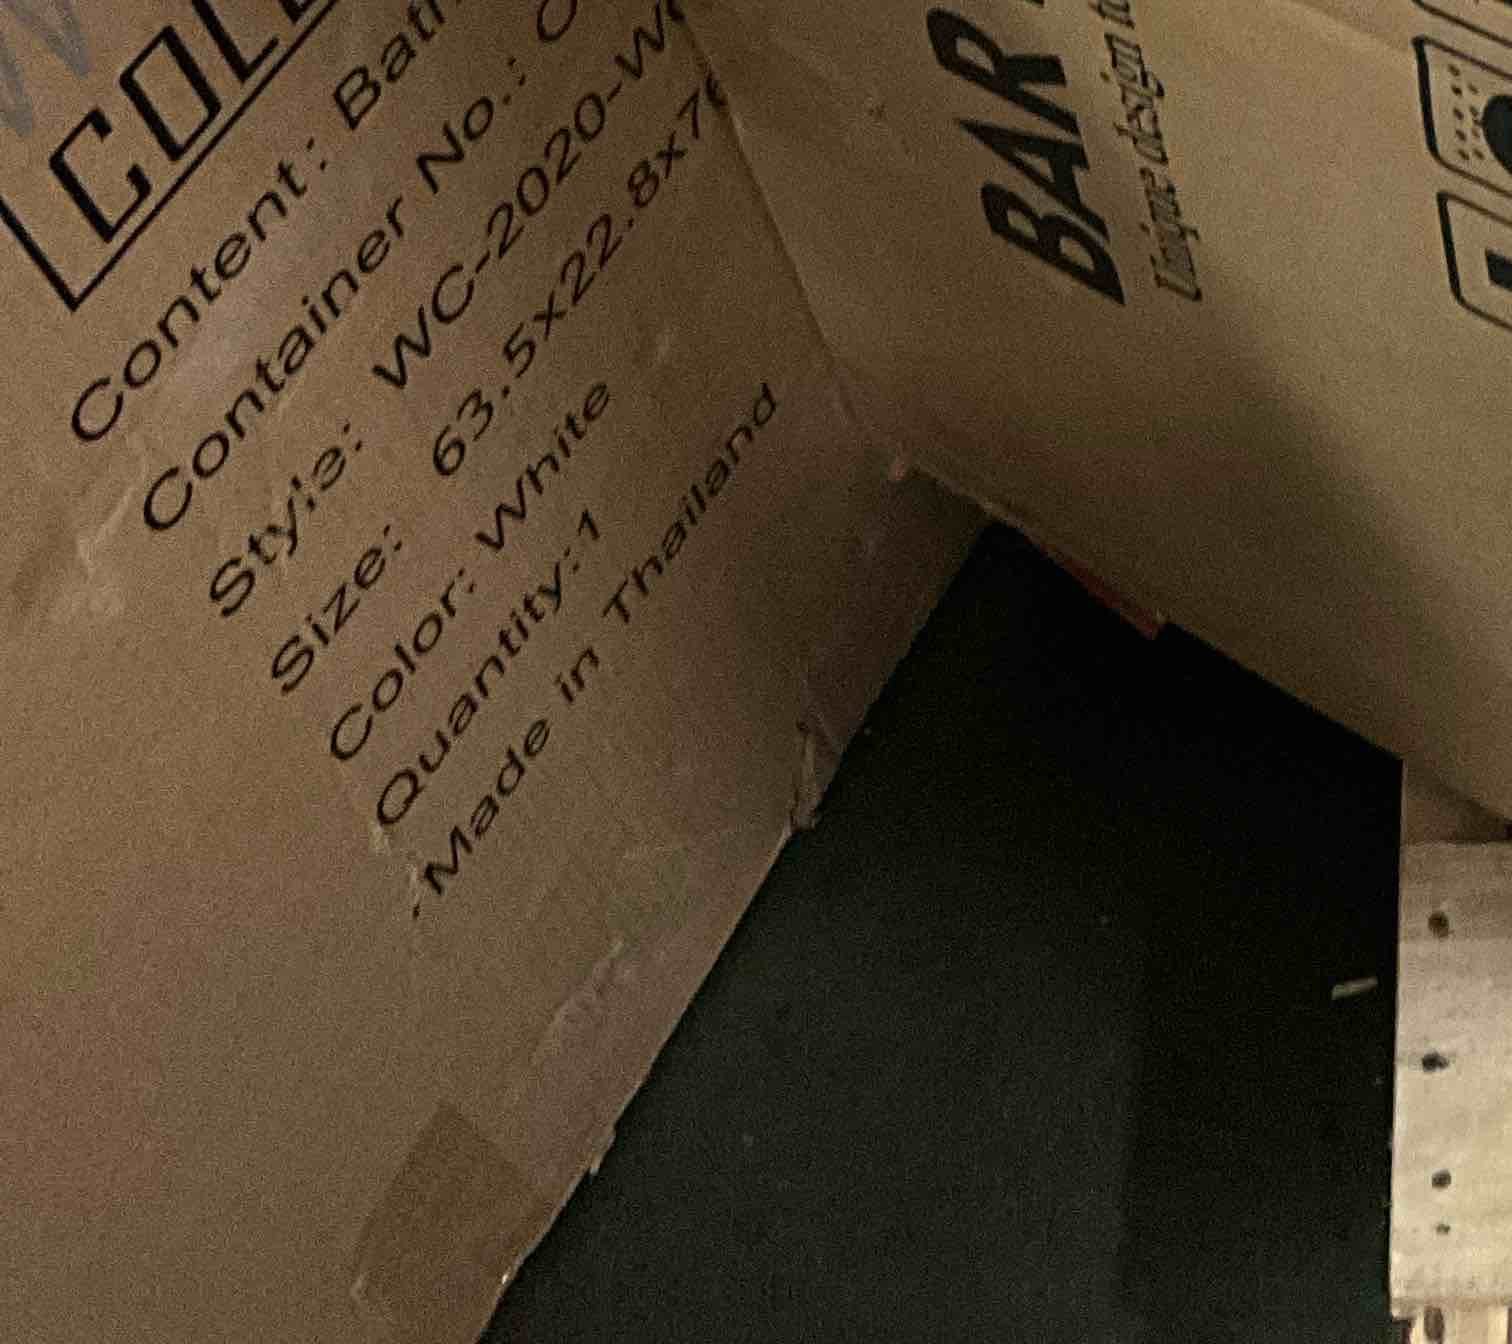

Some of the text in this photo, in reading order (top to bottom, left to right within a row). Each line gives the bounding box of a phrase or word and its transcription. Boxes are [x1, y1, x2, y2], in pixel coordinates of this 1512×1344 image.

[926, 6, 1127, 306] BAR
[1100, 33, 1168, 164] design
[71, 136, 328, 442] Content:
[143, 197, 404, 532] Container
[415, 57, 528, 195] No.:
[271, 524, 402, 697] Size:
[329, 382, 610, 760] Color: White
[375, 547, 580, 826] Quantity:
[423, 381, 779, 895] Made in Thailand
